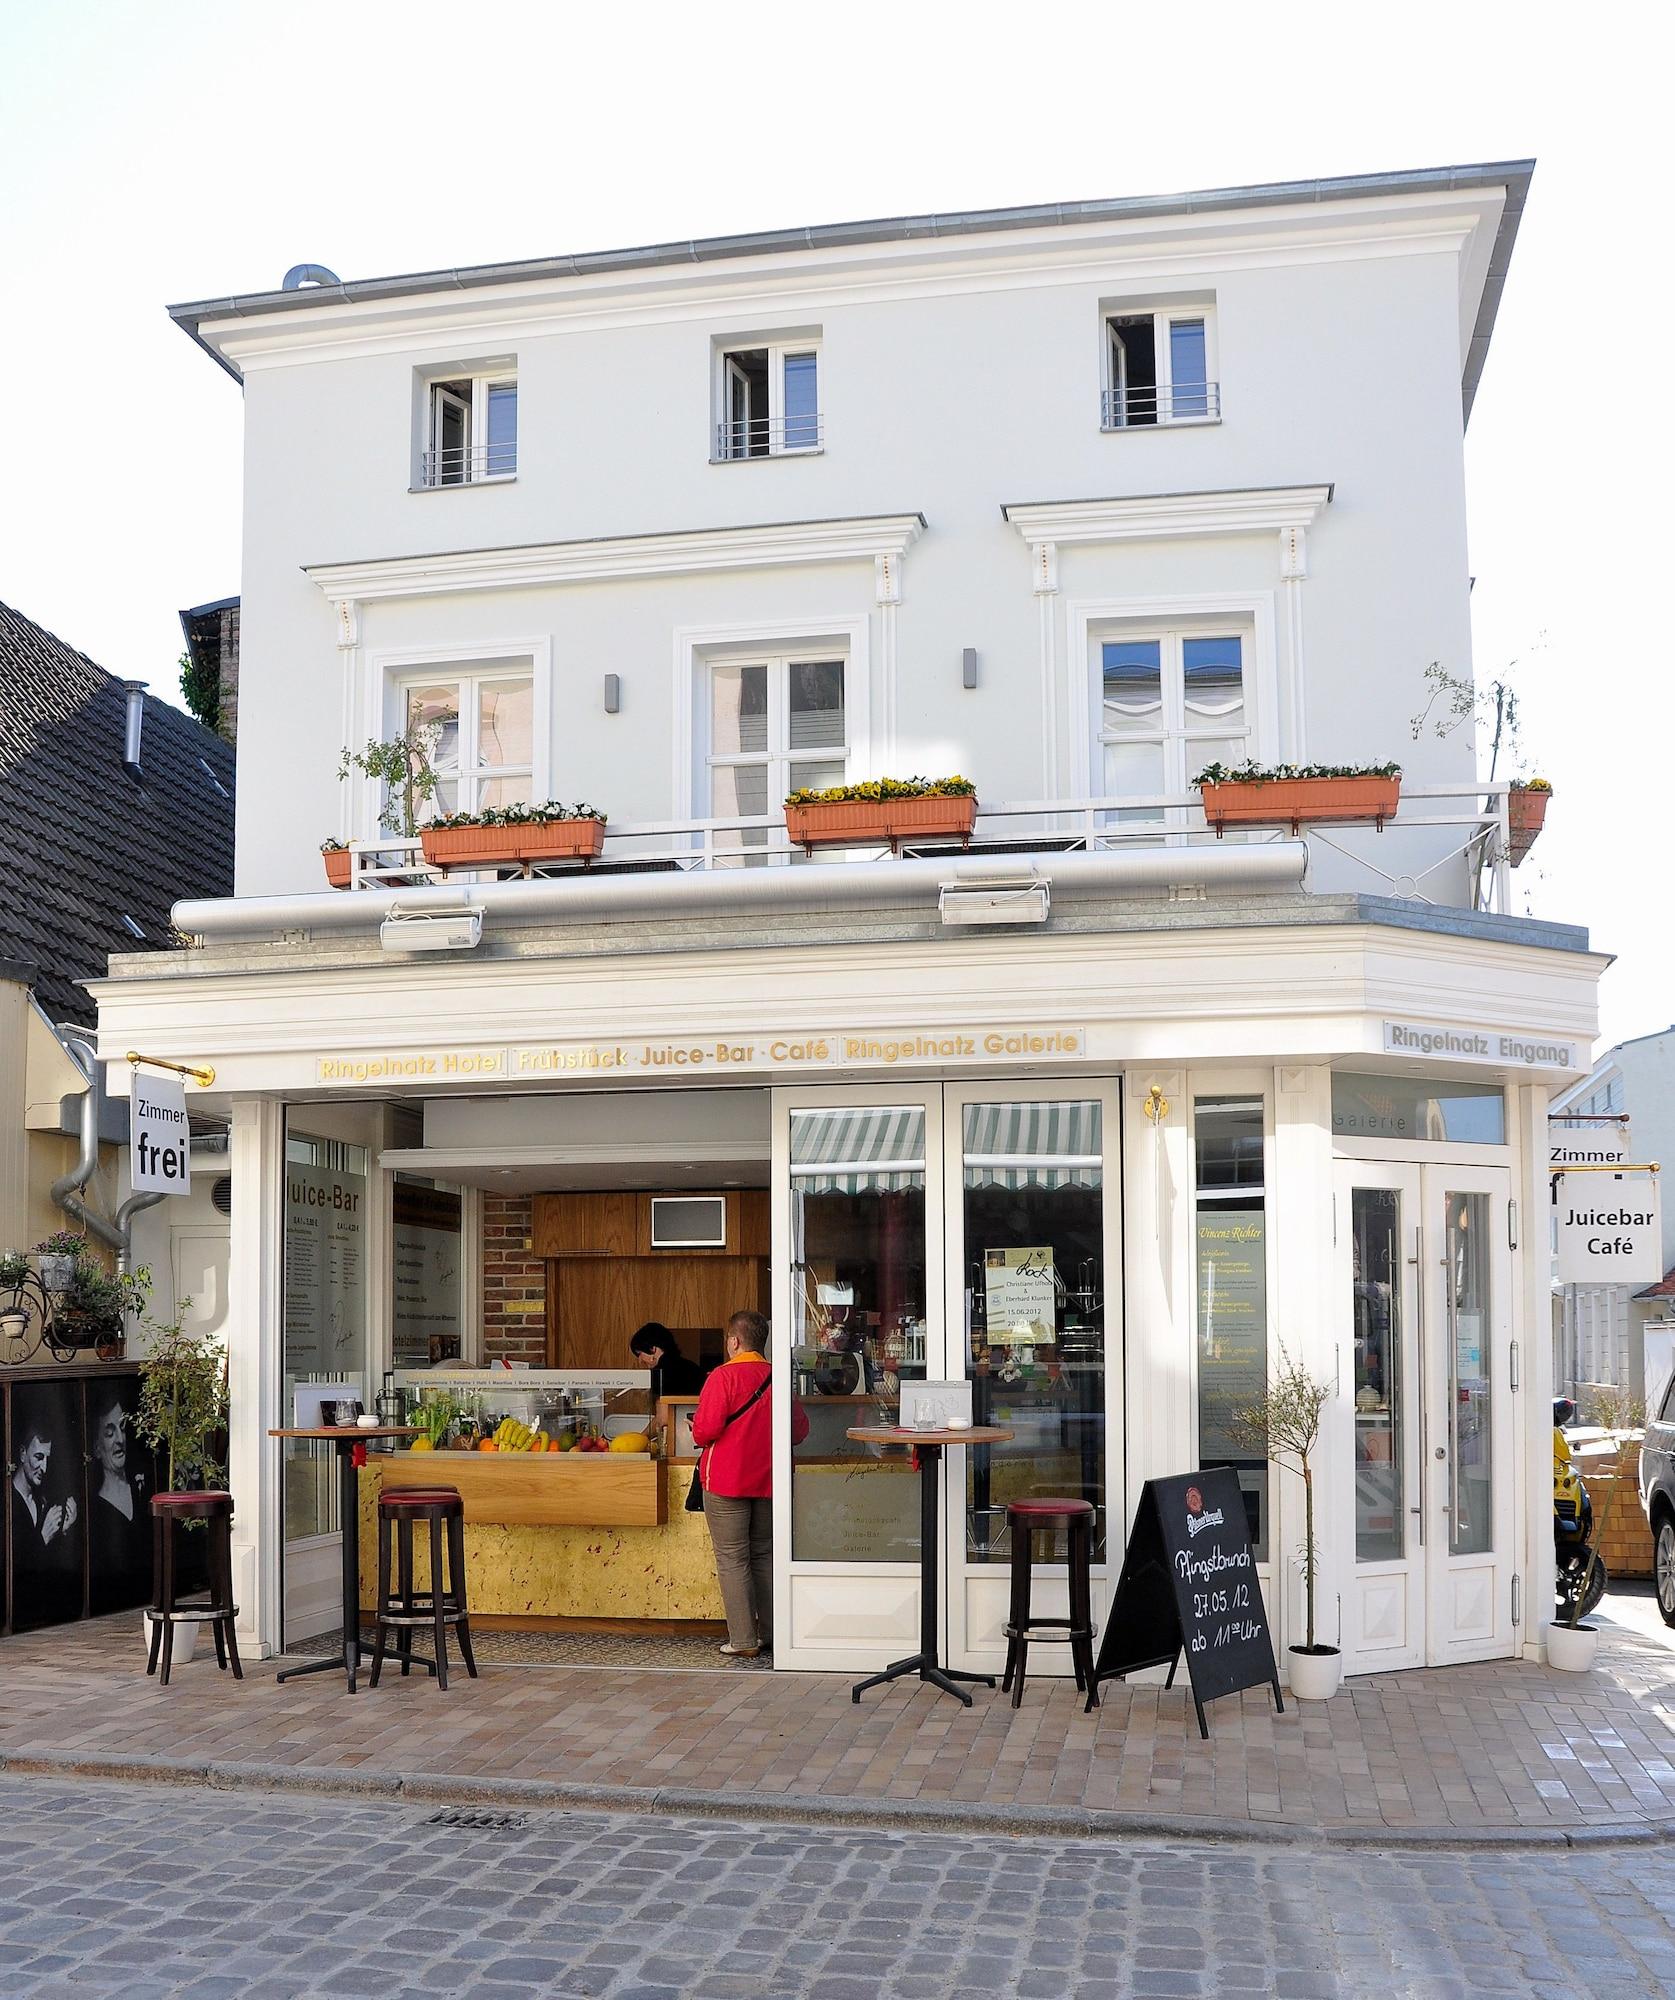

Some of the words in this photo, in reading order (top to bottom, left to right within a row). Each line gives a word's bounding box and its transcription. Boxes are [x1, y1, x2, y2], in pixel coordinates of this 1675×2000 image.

[518, 1046, 628, 1071] Frühstück
[639, 1043, 754, 1066] Juice-Bar
[770, 1038, 829, 1062] Café
[846, 1033, 976, 1062] Ringelnatz
[983, 1031, 1079, 1054] Galerie
[1391, 1025, 1489, 1055] Ringelnatz
[1498, 1035, 1570, 1067] Eingang
[320, 1057, 437, 1081] Ringelnatz
[443, 1052, 503, 1073] Hotel
[137, 1098, 185, 1124] Zimmer
[137, 1132, 186, 1179] frei
[1550, 1147, 1624, 1163] Zimmer
[1565, 1208, 1655, 1226] Juicebar
[1587, 1237, 1634, 1255] Café
[1175, 1543, 1250, 1584] Pfingstbrunch
[1191, 1629, 1207, 1652] ab
[1240, 1619, 1262, 1641] Uhr
